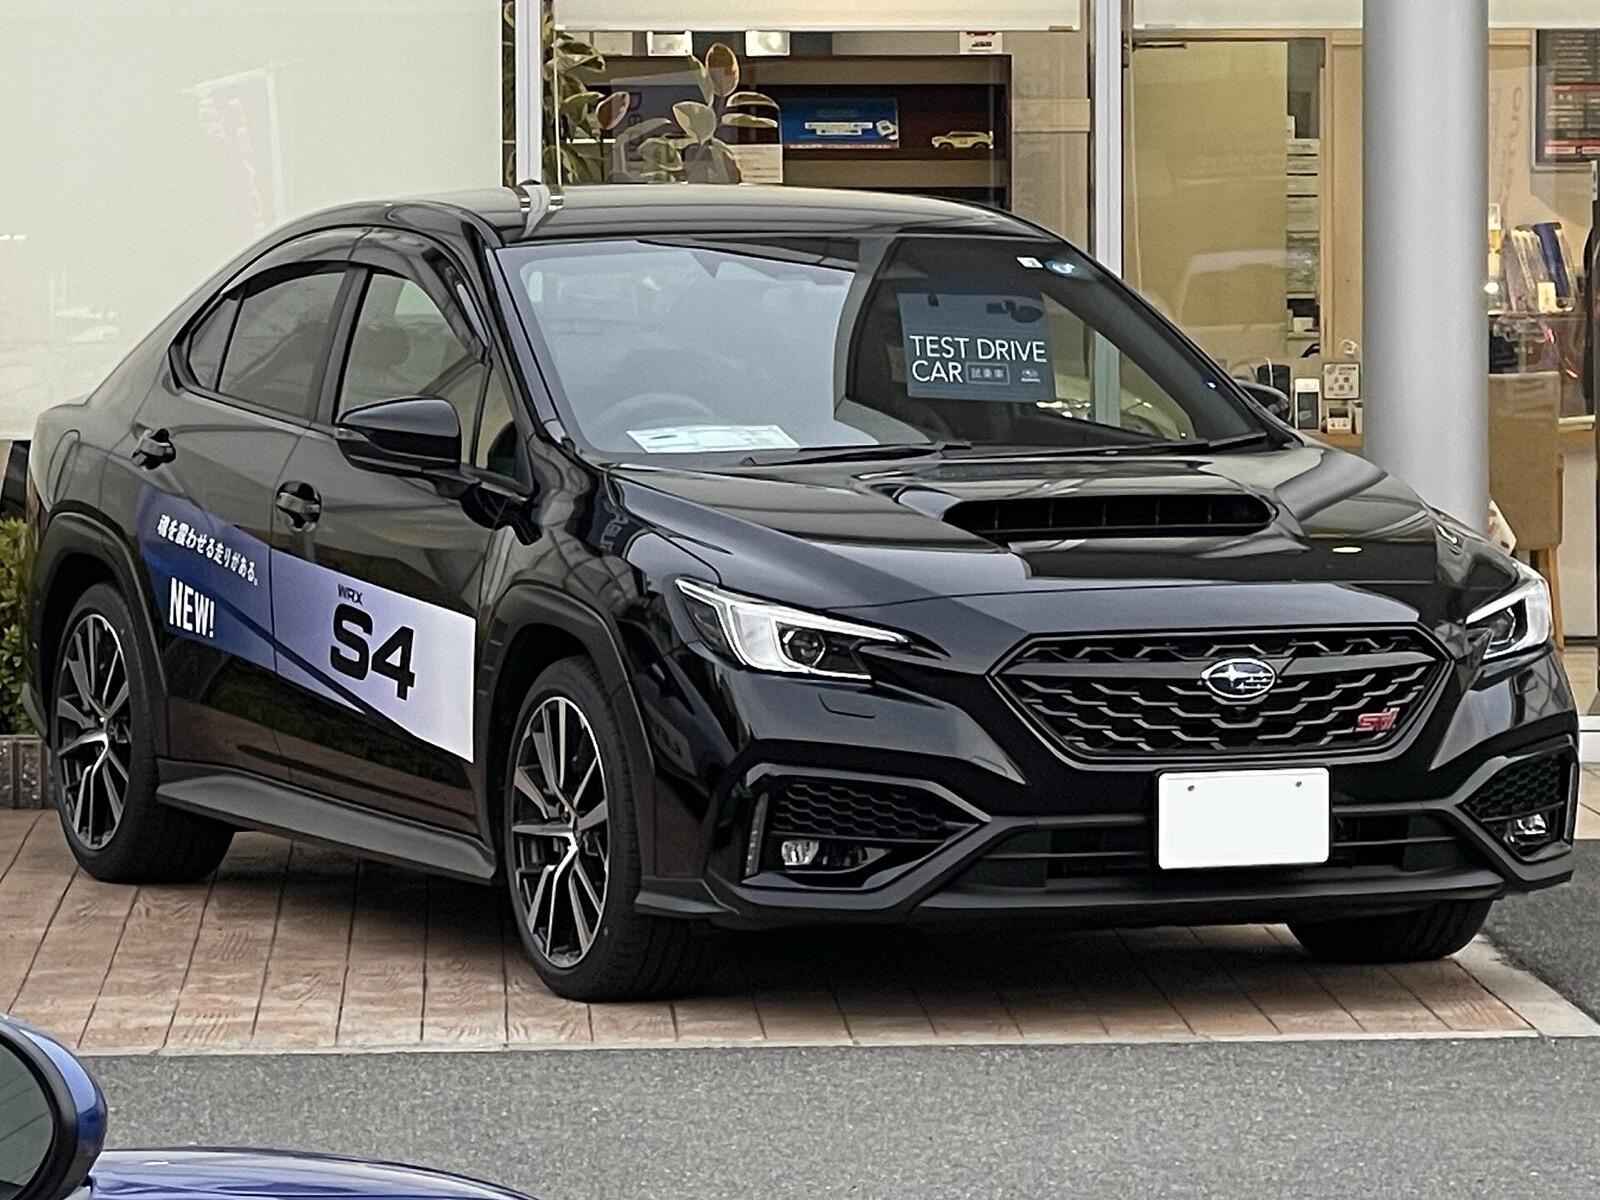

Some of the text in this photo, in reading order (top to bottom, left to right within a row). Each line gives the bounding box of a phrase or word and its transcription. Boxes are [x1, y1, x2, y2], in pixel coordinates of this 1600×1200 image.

[909, 335, 1048, 363] TEST DRIVE
[911, 359, 963, 383] CAR
[169, 577, 216, 638] NEW!
[337, 583, 364, 606] WRX
[330, 602, 416, 701] S4
